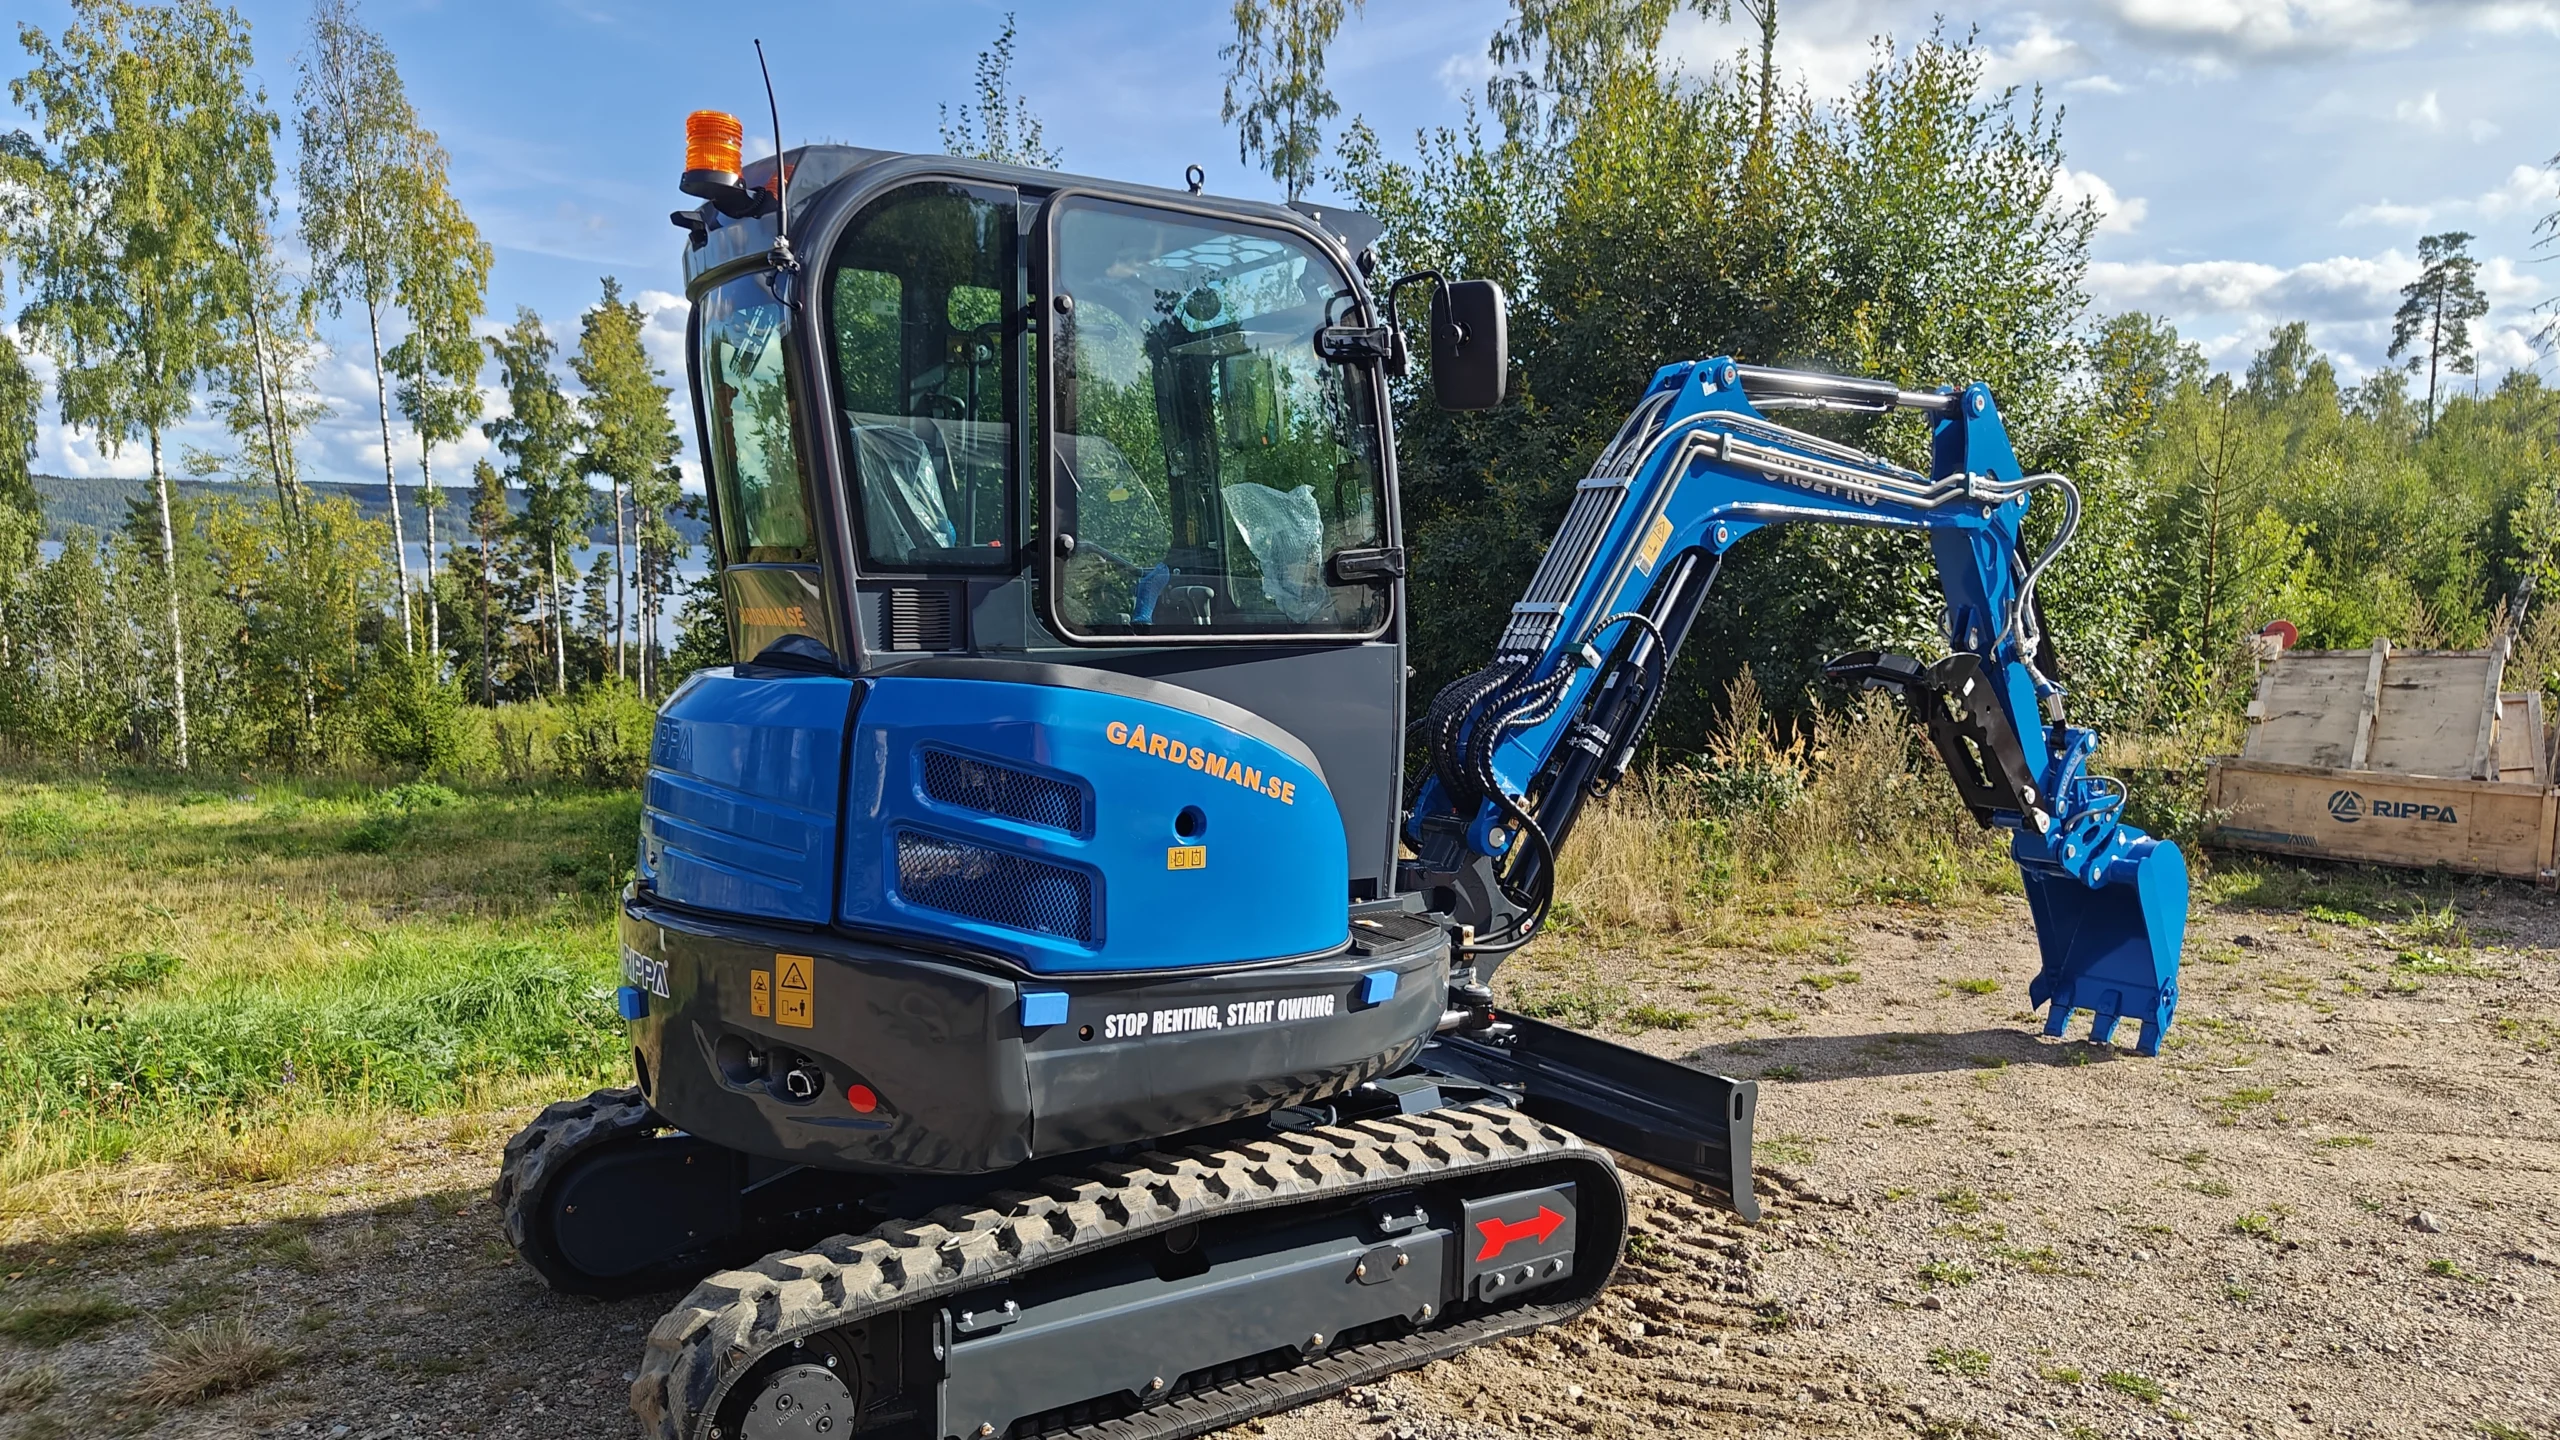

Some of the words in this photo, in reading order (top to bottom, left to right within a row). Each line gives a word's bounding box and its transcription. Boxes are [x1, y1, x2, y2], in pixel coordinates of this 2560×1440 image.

[652, 720, 693, 762] IPPA
[1106, 721, 1296, 805] GÅRDSMAN.SE
[2372, 800, 2458, 823] RIPPA
[624, 943, 670, 999] RIPPA
[1104, 1012, 1148, 1039] STOP
[1152, 1005, 1222, 1034] RENTING,
[1227, 1000, 1275, 1026] START
[1277, 994, 1335, 1021] OWNING
